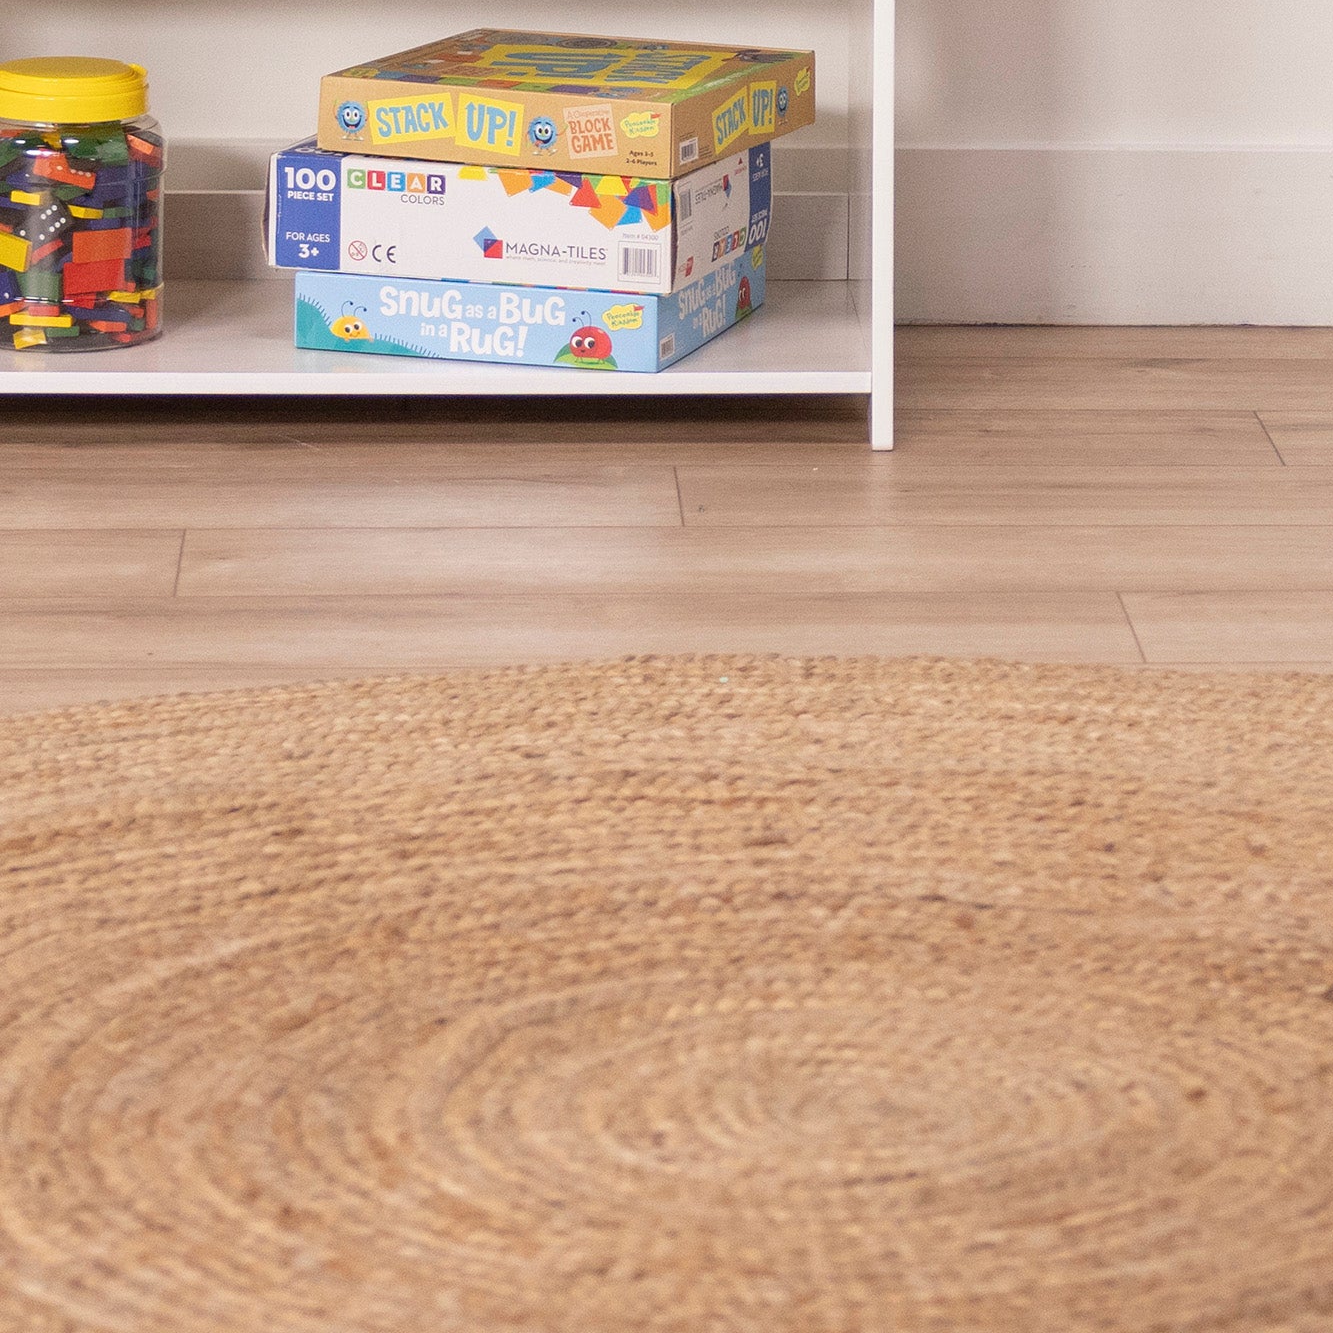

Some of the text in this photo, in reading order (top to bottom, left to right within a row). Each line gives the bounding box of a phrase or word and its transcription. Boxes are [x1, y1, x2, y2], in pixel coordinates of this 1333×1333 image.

[375, 101, 518, 147] STACK UP!
[715, 89, 773, 145] STACK UP!
[568, 118, 612, 134] BLOCK
[571, 133, 614, 153] GAME
[284, 167, 337, 191] 100
[349, 171, 443, 193] CLEAR
[287, 191, 334, 202] PIECE SET
[400, 194, 445, 206] COLORS
[286, 232, 330, 243] FOR AGES
[748, 218, 767, 245] 100
[298, 244, 320, 259] 3+
[506, 242, 606, 260] MAGNA-TILES
[465, 304, 483, 319] as
[487, 305, 497, 319] a
[420, 322, 435, 336] in
[438, 323, 448, 338] a
